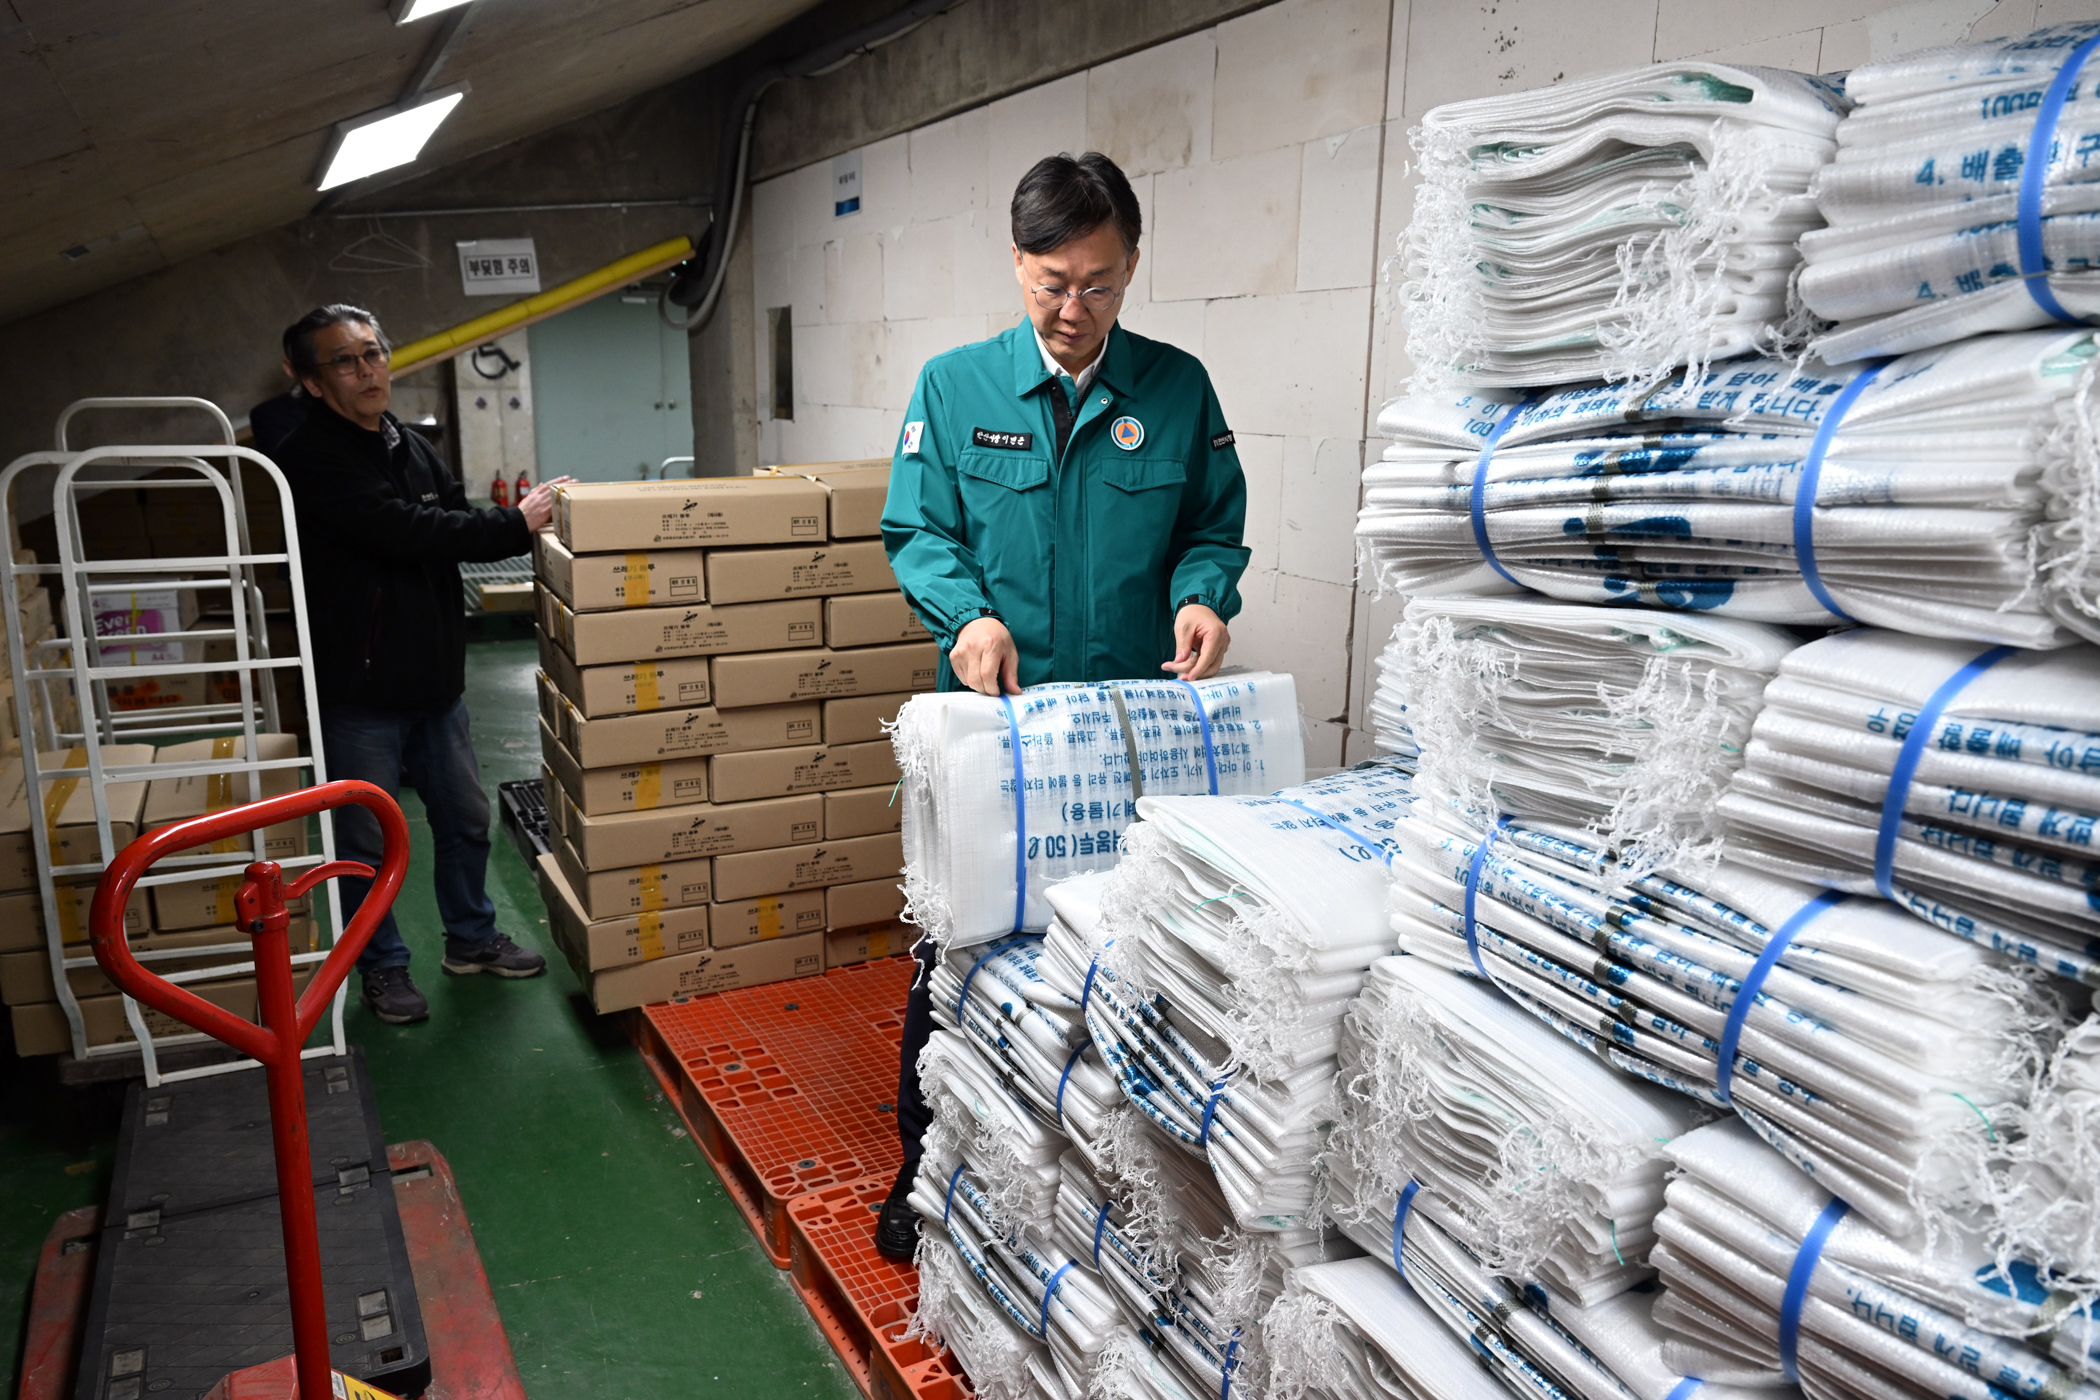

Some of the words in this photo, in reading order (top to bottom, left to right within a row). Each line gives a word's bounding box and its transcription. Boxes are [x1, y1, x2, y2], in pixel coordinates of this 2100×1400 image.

[507, 256, 530, 275] 주의
[96, 614, 132, 632] Ever
[1066, 710, 1111, 725] 주십시오.
[1150, 765, 1179, 781] 도자기
[1214, 760, 1237, 774] 마대
[1048, 774, 1067, 790] 불에
[1072, 773, 1081, 788] 등
[1087, 772, 1107, 786] 유리
